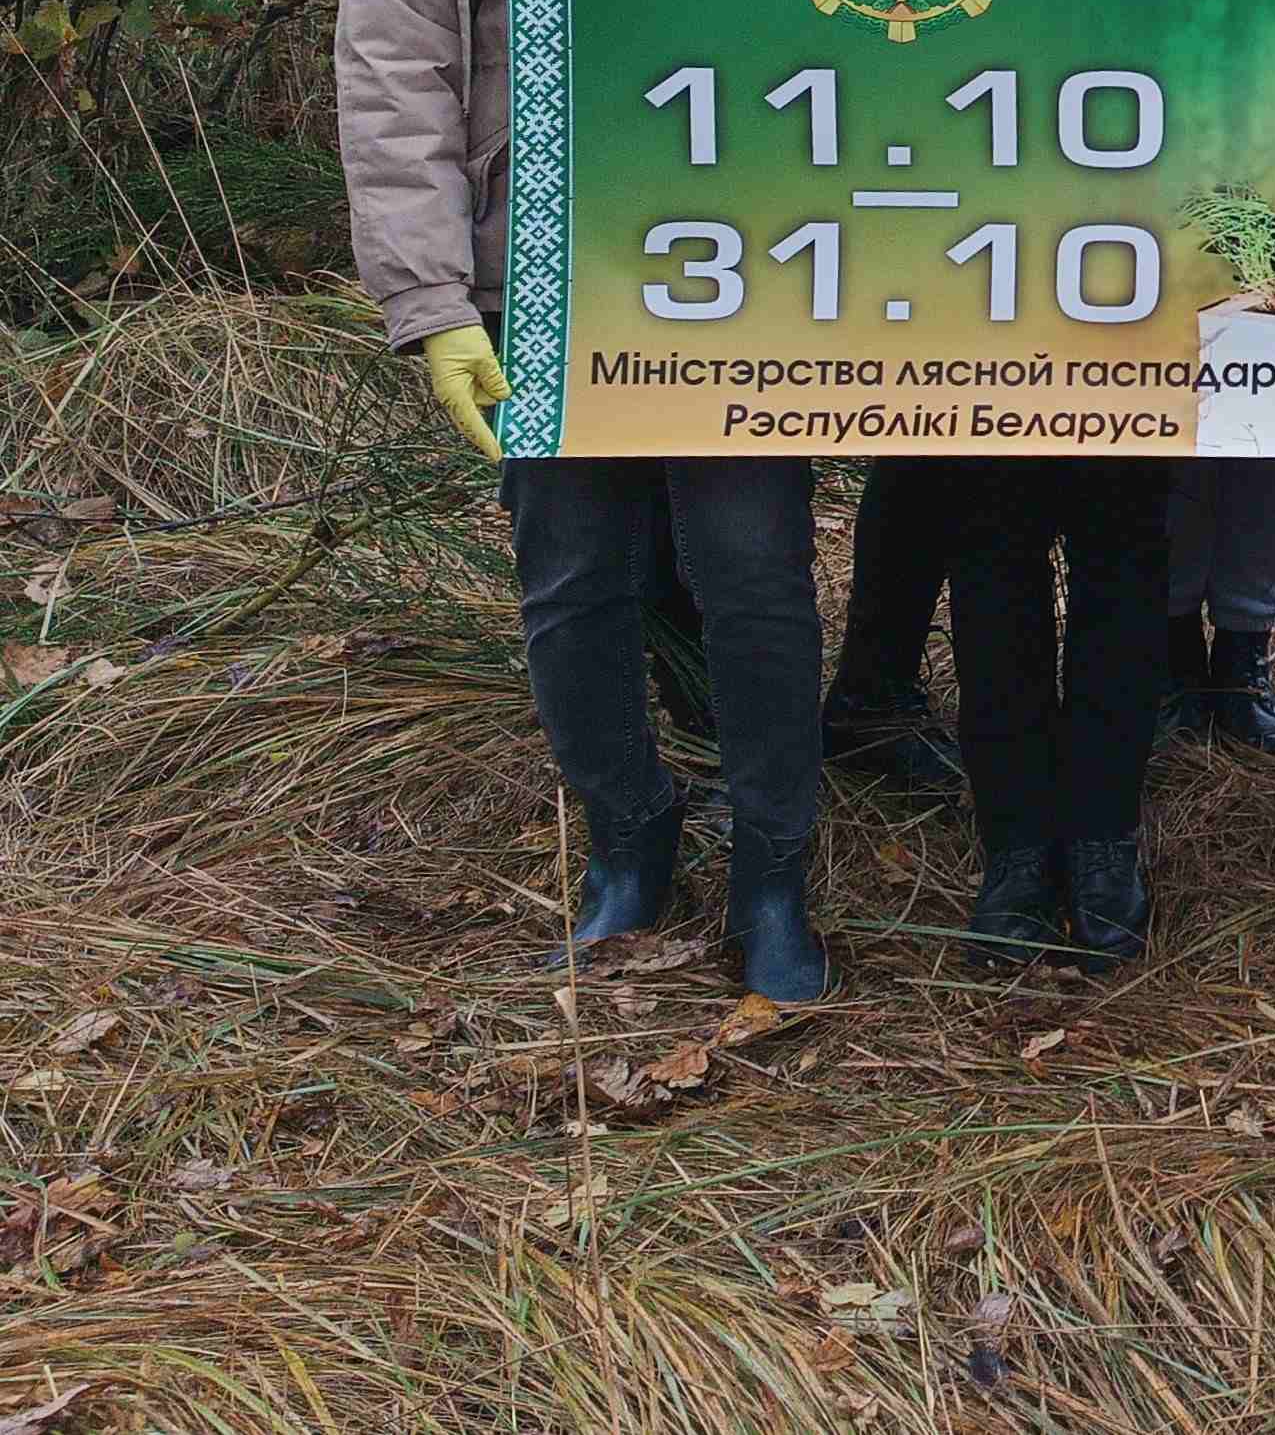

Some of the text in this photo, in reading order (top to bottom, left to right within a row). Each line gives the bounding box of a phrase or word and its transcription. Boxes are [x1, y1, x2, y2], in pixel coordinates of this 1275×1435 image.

[643, 67, 1165, 168] 11.10
[640, 221, 1161, 323] 31.10
[590, 351, 884, 392] Міністэрства
[895, 351, 1053, 389] лясной
[722, 404, 1180, 443] Рэспублікі Беларусь
